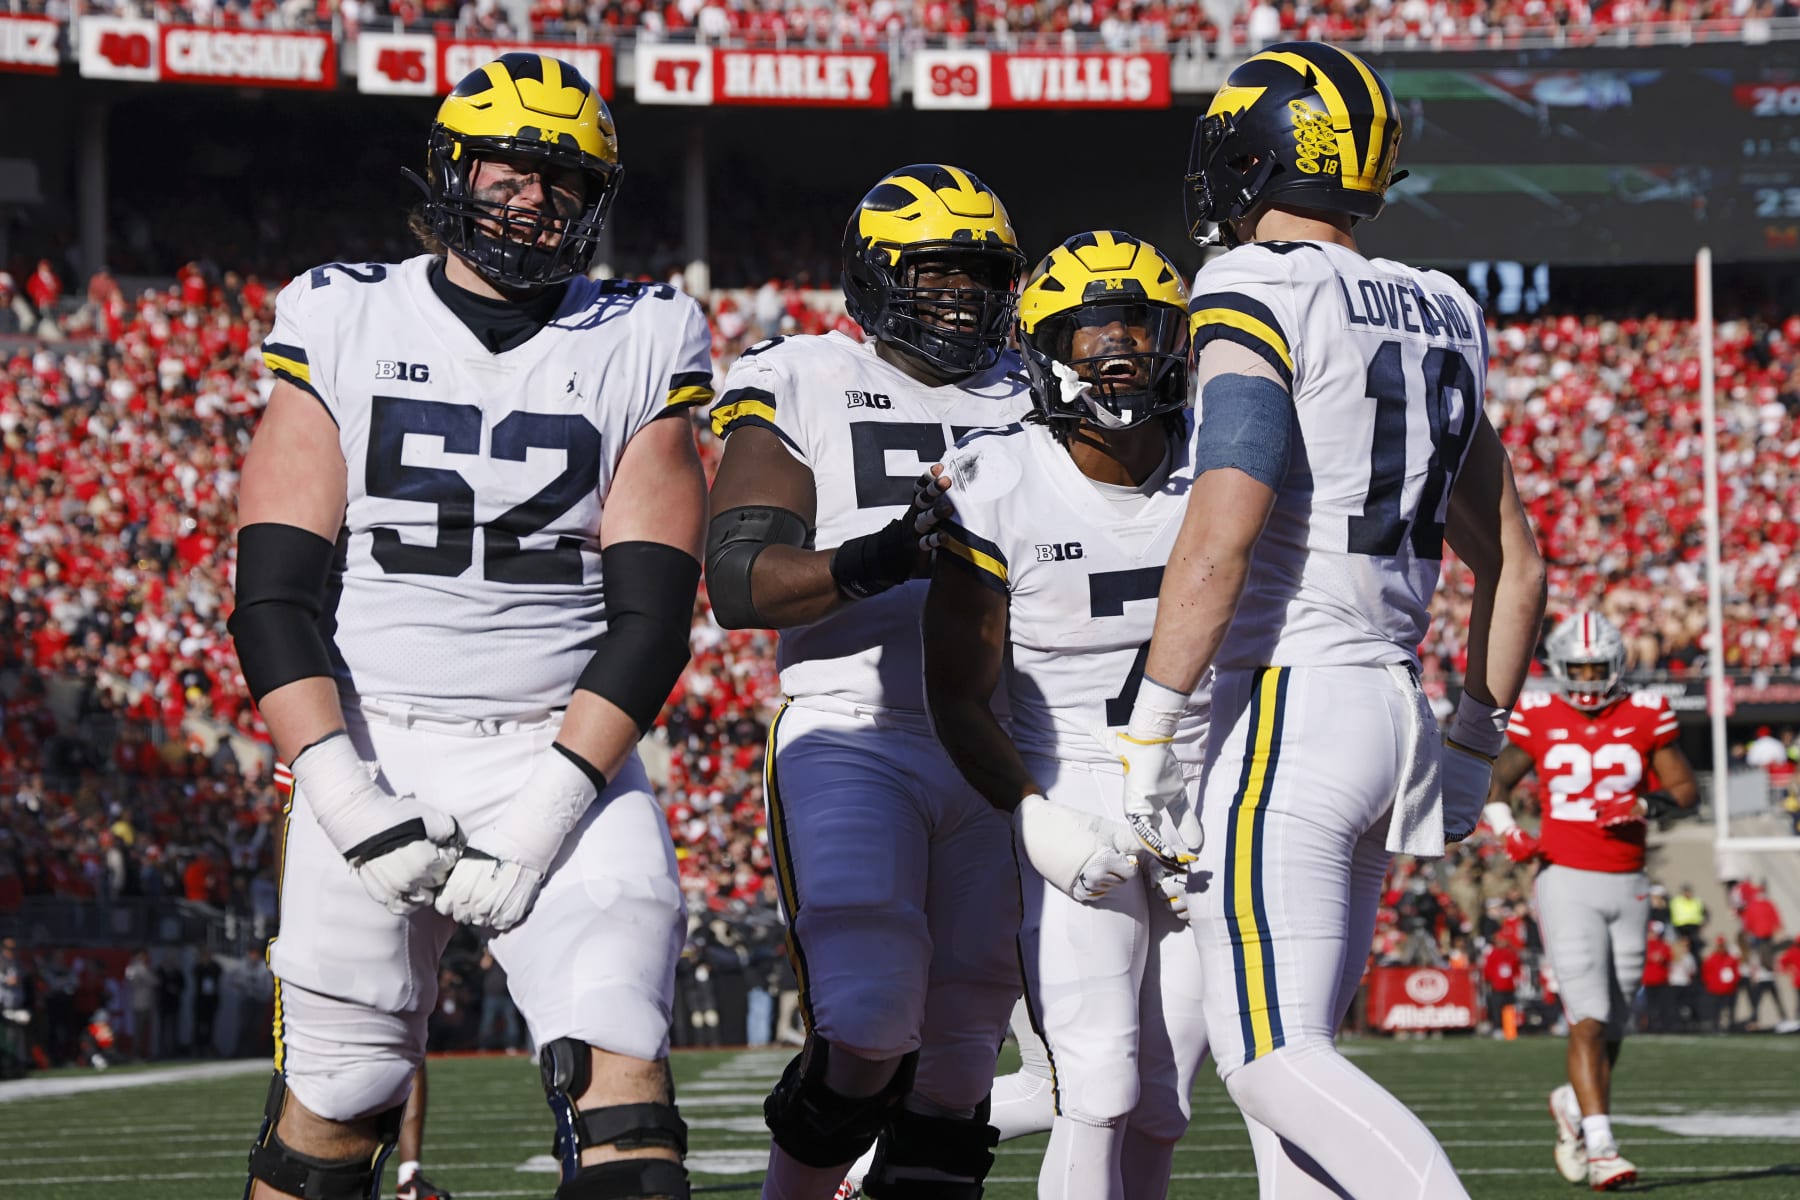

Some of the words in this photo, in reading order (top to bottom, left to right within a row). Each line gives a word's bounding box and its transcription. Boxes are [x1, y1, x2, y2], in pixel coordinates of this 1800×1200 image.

[166, 29, 327, 82] CASSADY
[653, 60, 701, 92] 47
[723, 53, 876, 100] HARLEY
[930, 65, 978, 97] 99
[1006, 57, 1152, 101] WILLIS
[1322, 158, 1338, 175] 18
[1339, 276, 1473, 340] LOVELAND
[850, 421, 1002, 509] 5
[1347, 340, 1475, 560] 18
[366, 395, 601, 585] 52
[1088, 565, 1166, 727] 7
[1544, 743, 1642, 822] 22
